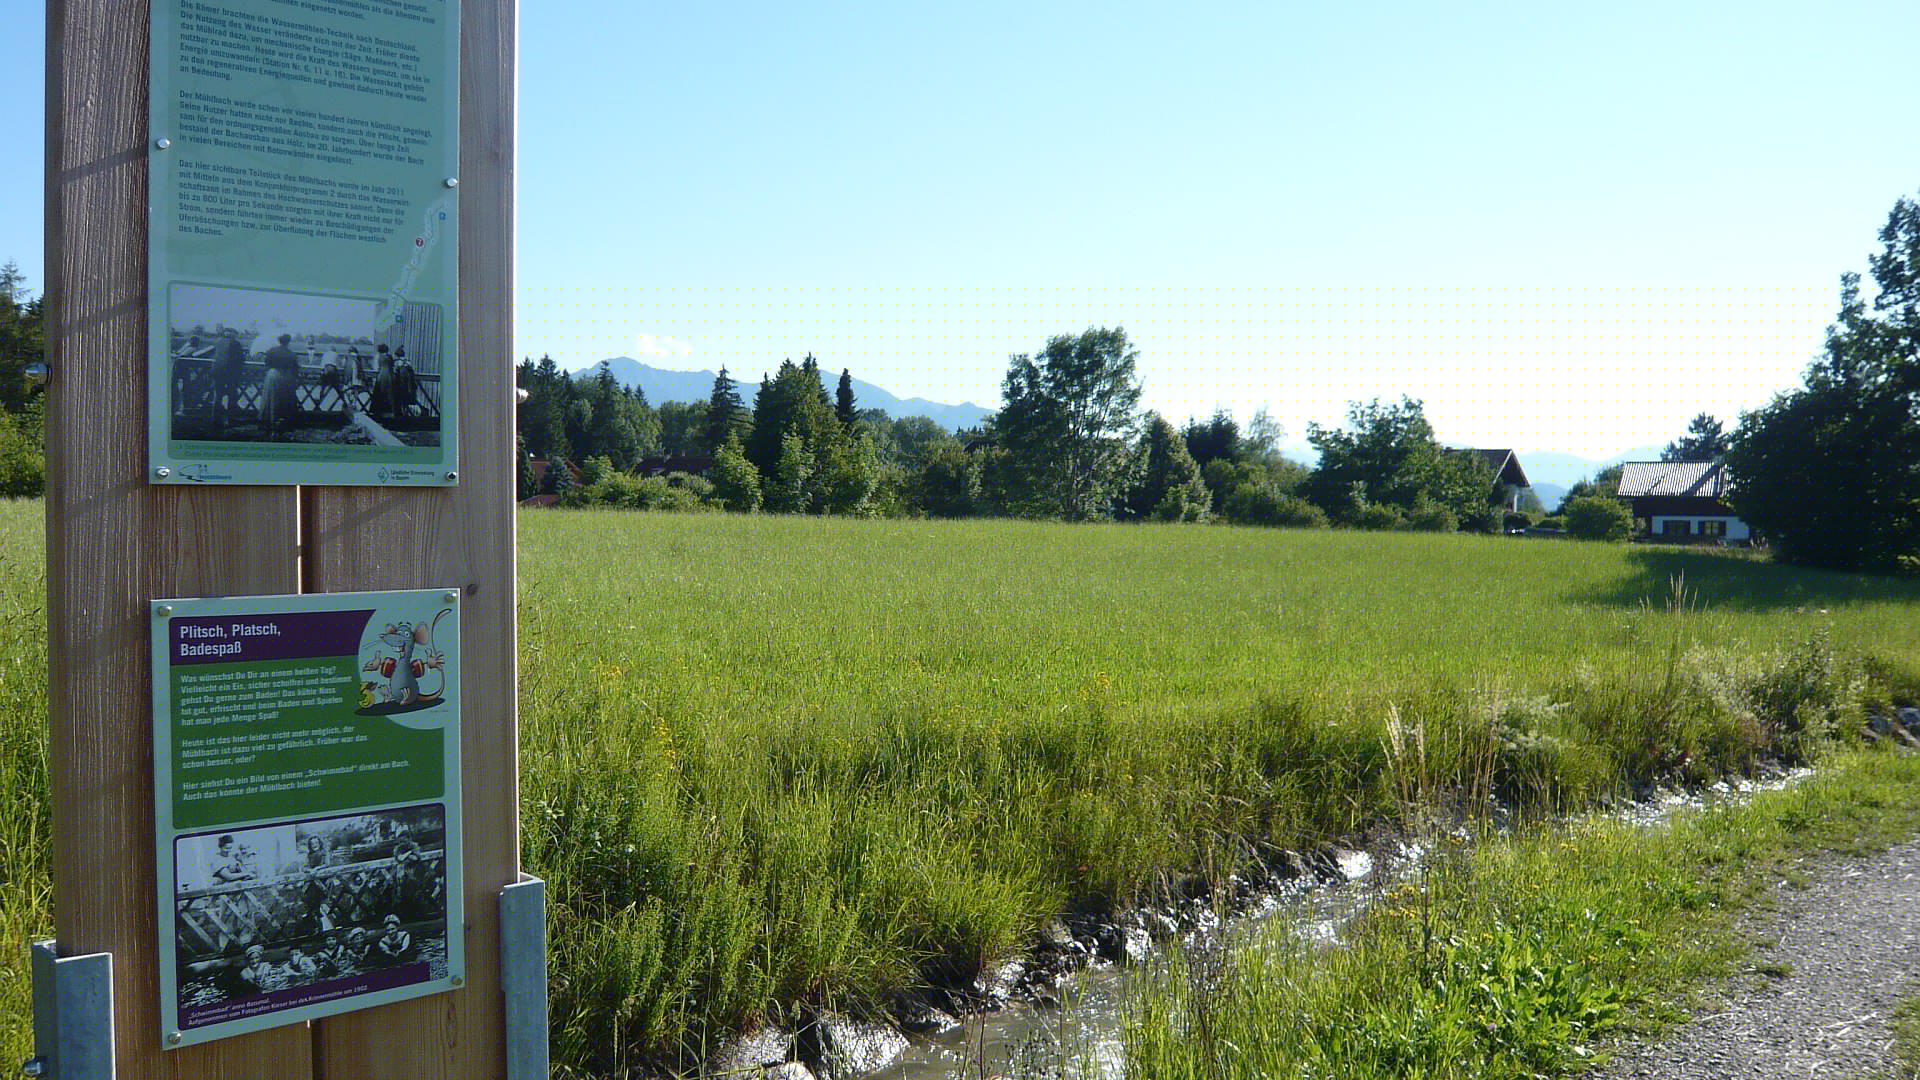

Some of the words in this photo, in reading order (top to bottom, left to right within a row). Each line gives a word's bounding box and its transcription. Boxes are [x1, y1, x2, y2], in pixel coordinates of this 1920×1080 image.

[180, 11, 192, 20] Die
[180, 90, 192, 99] Der
[179, 159, 192, 168] Das
[180, 624, 228, 641] Plitsch,
[232, 623, 282, 639] Platsch,
[180, 641, 242, 658] Badespaß
[180, 674, 197, 682] Was
[250, 775, 264, 783] Bild
